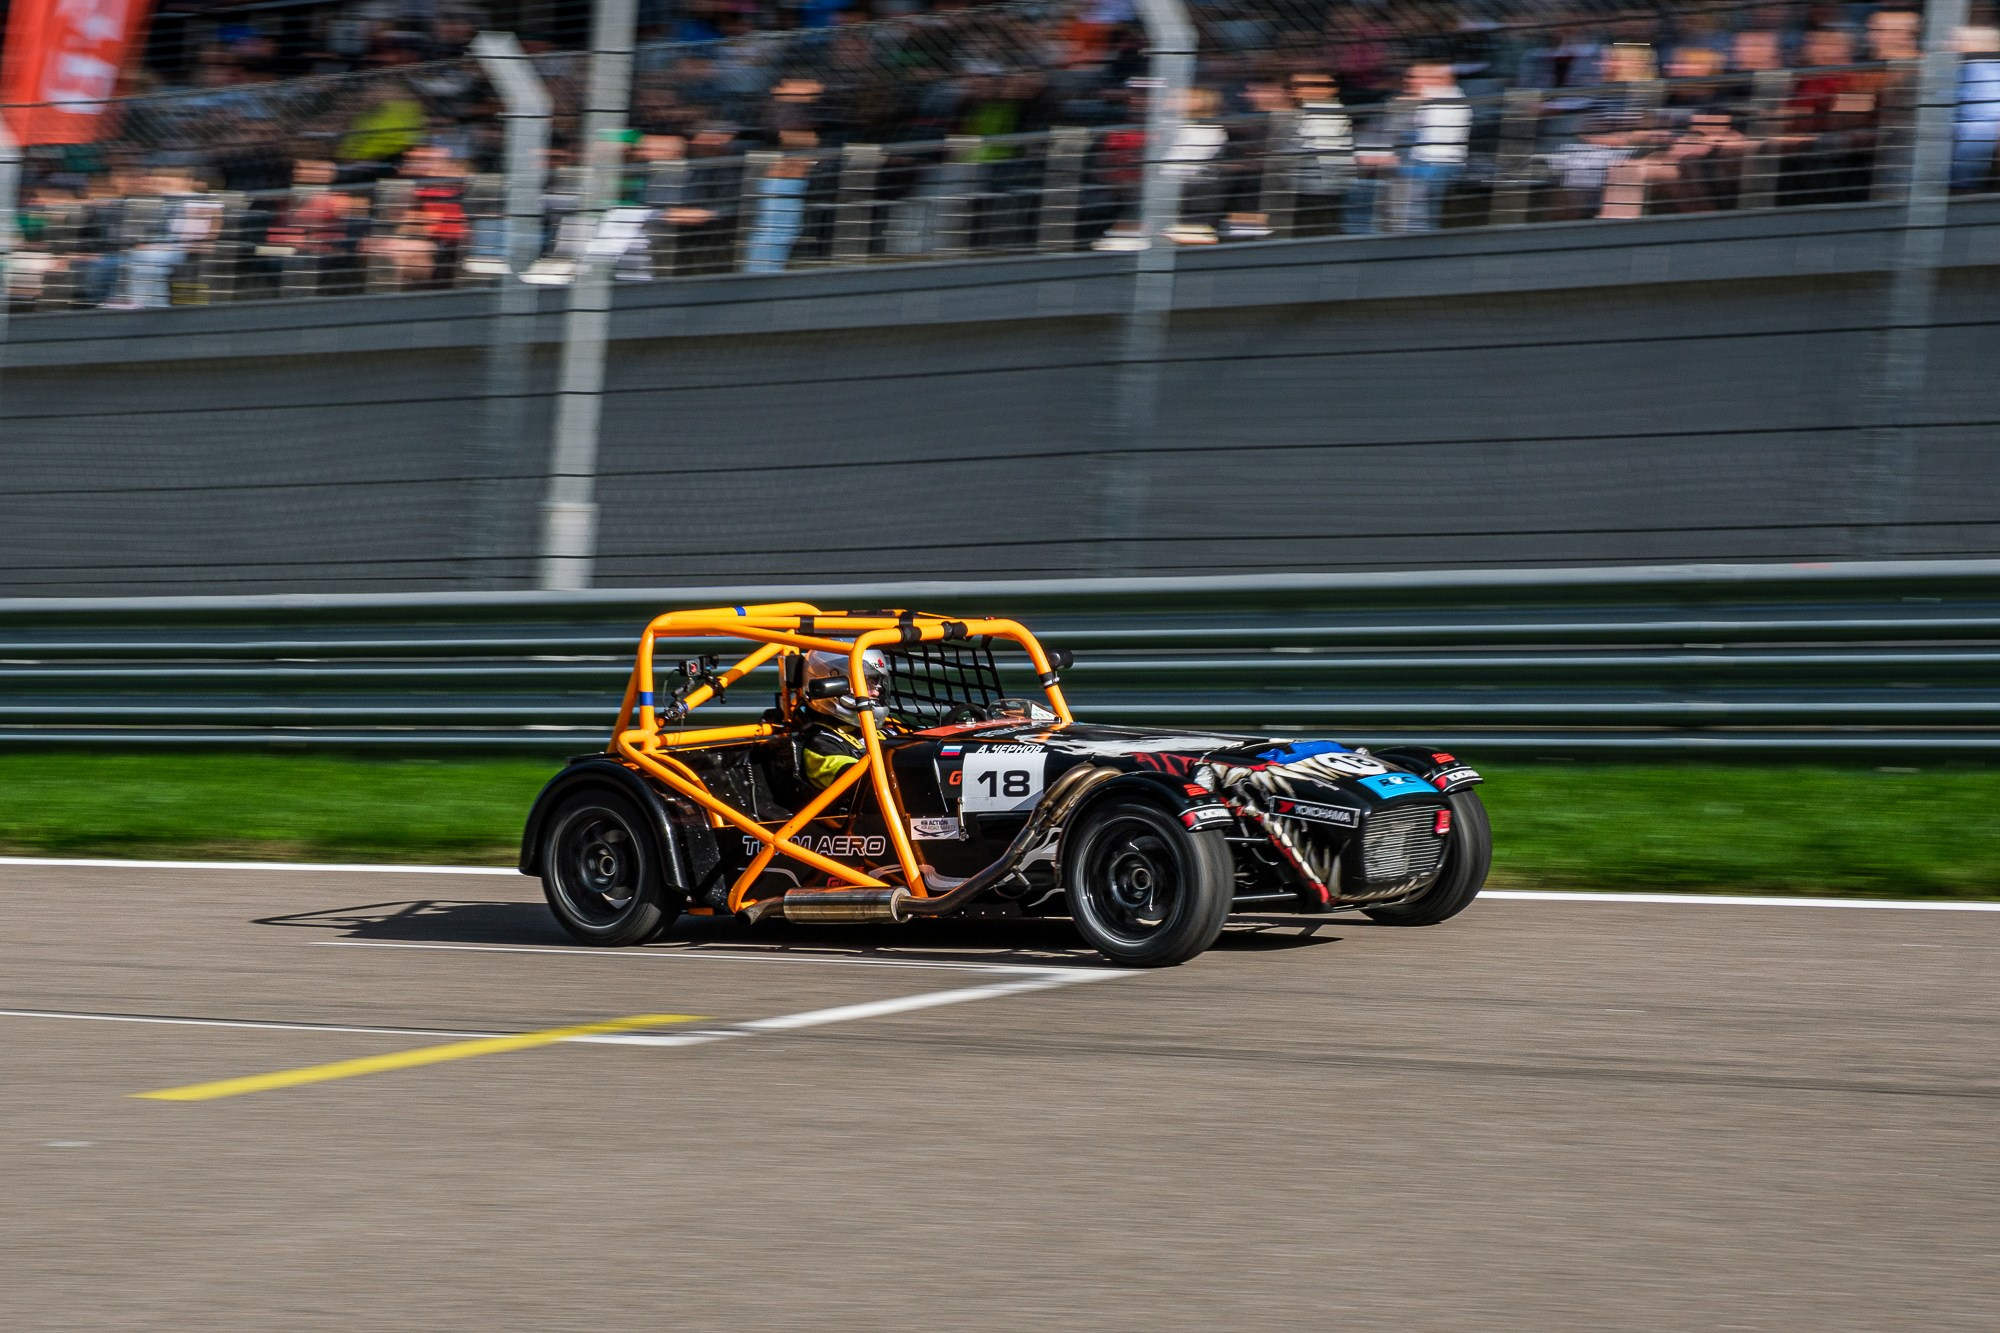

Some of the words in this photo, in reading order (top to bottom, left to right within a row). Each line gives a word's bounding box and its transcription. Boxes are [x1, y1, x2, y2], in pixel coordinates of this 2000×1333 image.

[977, 770, 1030, 797] 18
[1294, 804, 1351, 822] YOKOHAMA
[815, 835, 886, 856] AERO
